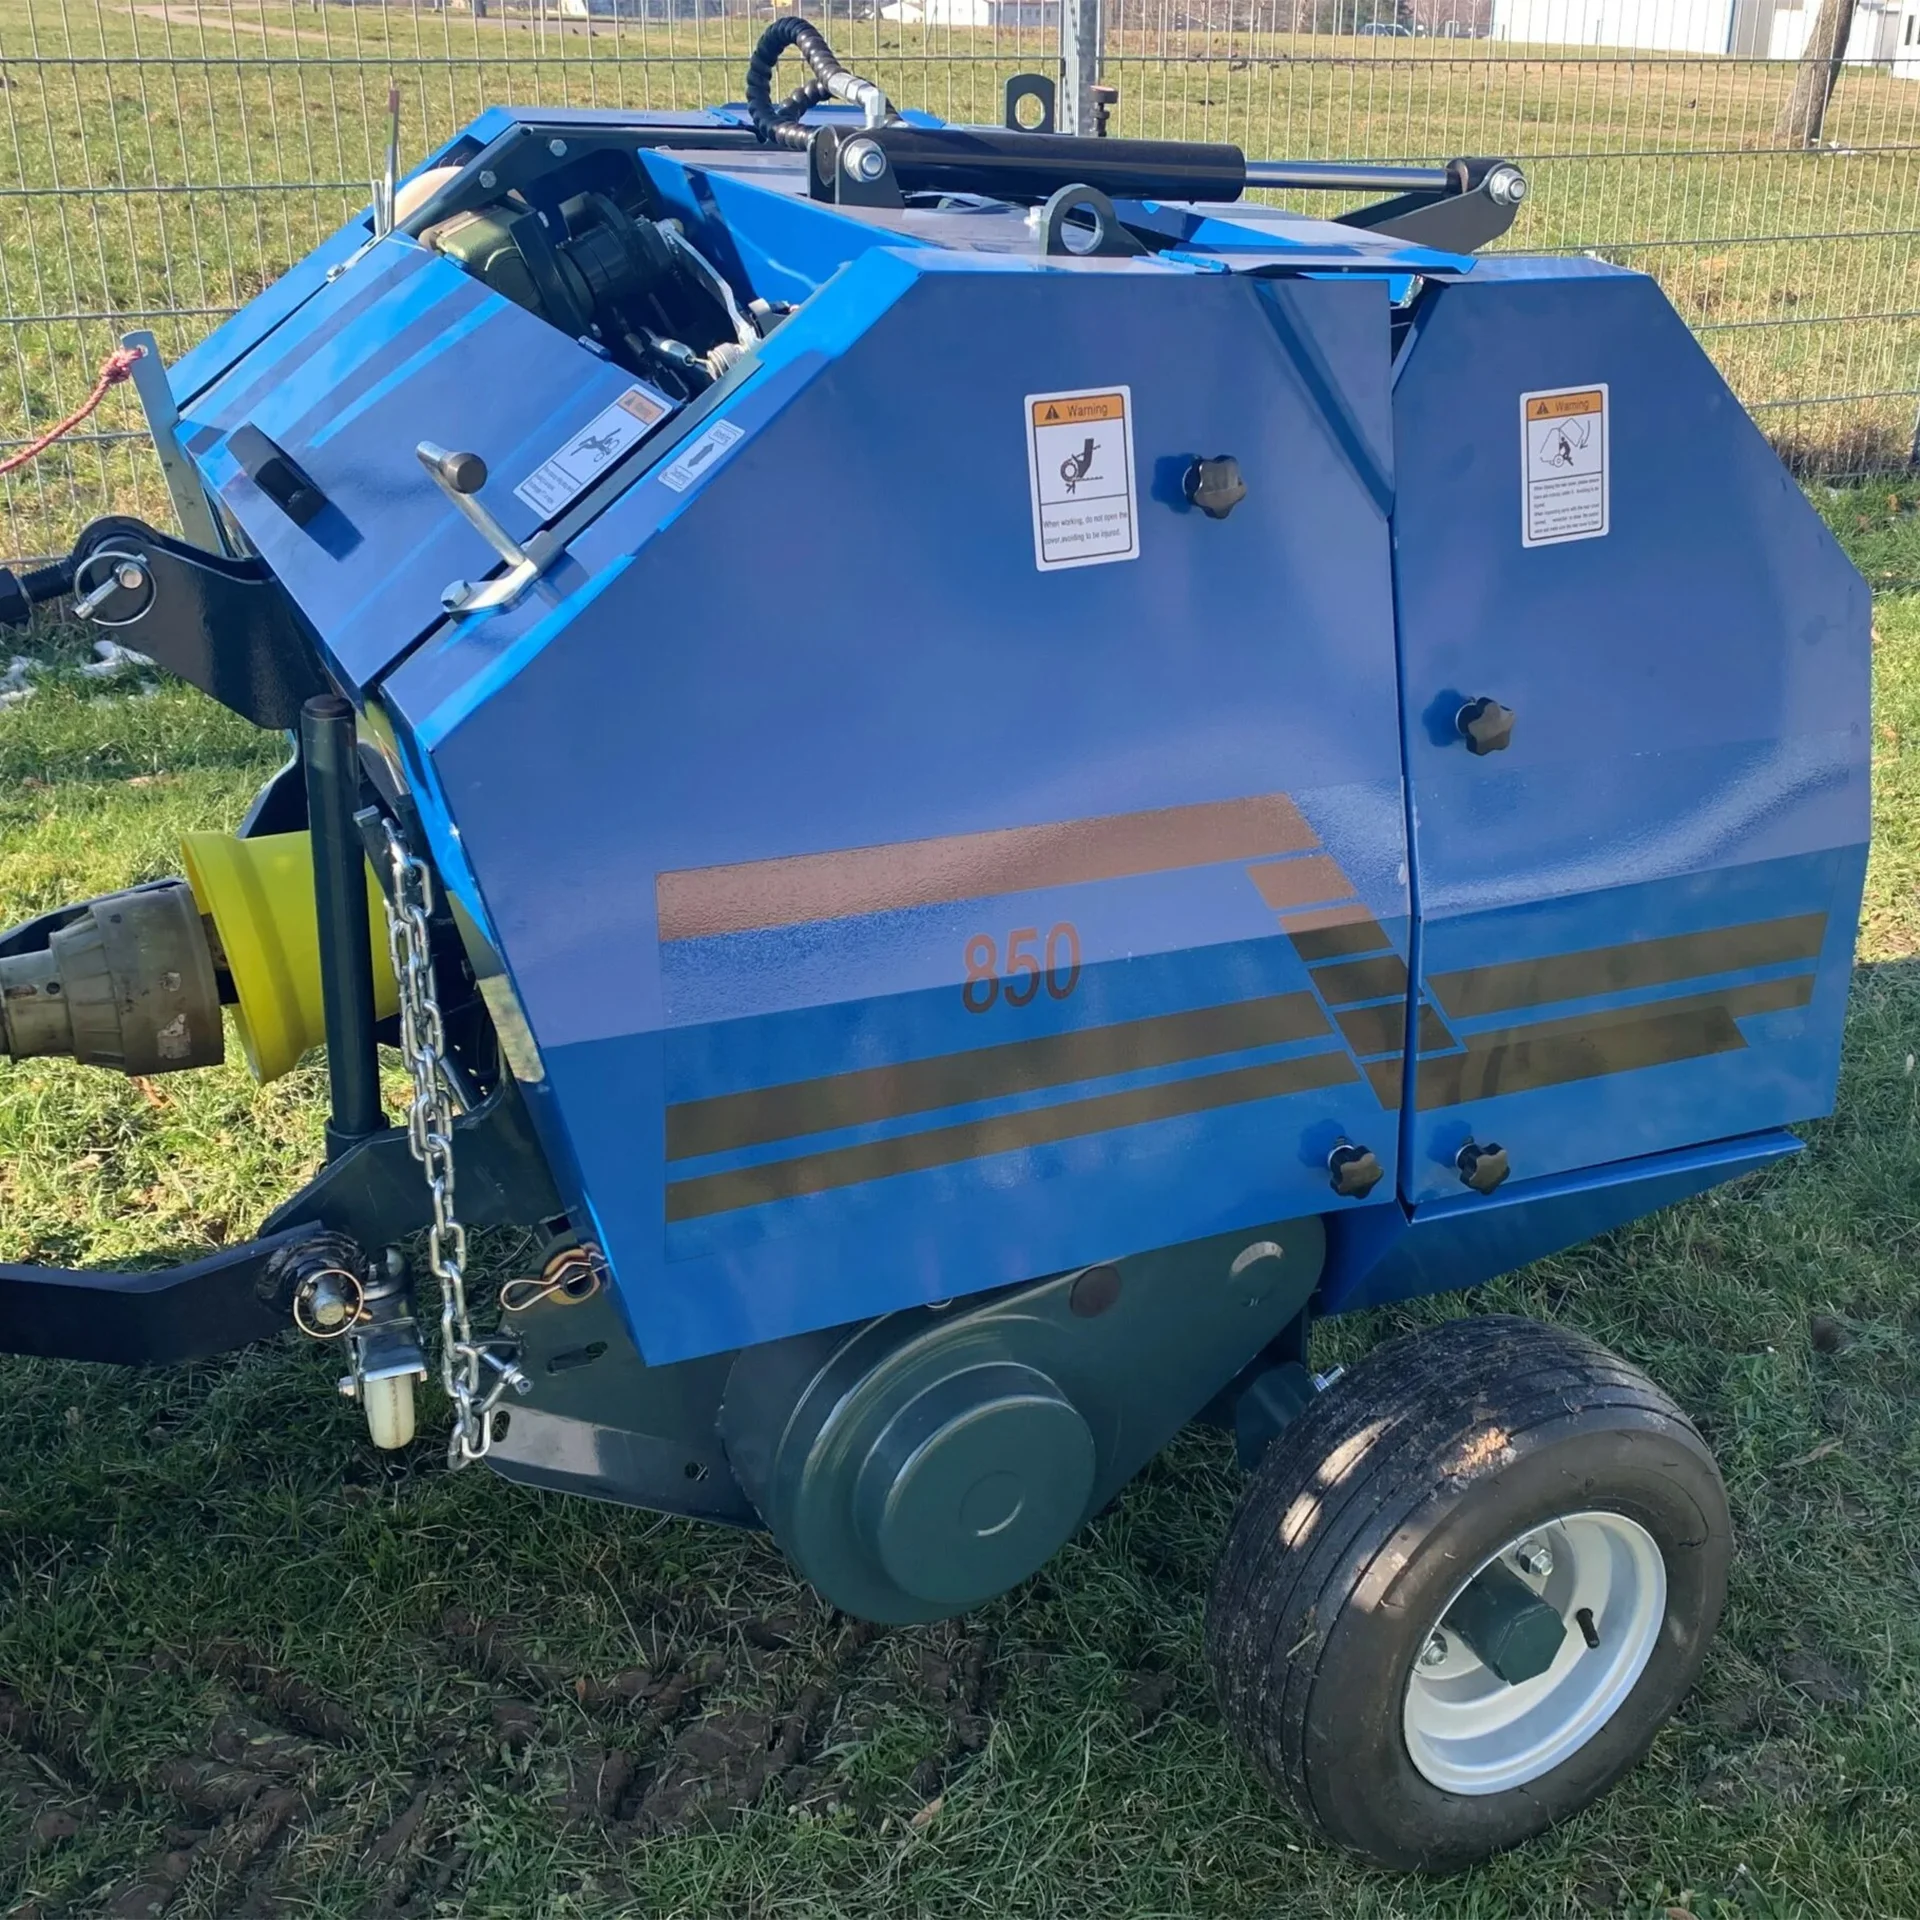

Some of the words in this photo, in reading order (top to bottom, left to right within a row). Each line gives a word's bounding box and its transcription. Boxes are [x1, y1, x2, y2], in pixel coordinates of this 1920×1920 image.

[1066, 402, 1108, 417] Warning
[1554, 398, 1589, 412] Warning
[962, 920, 1082, 1014] 850
